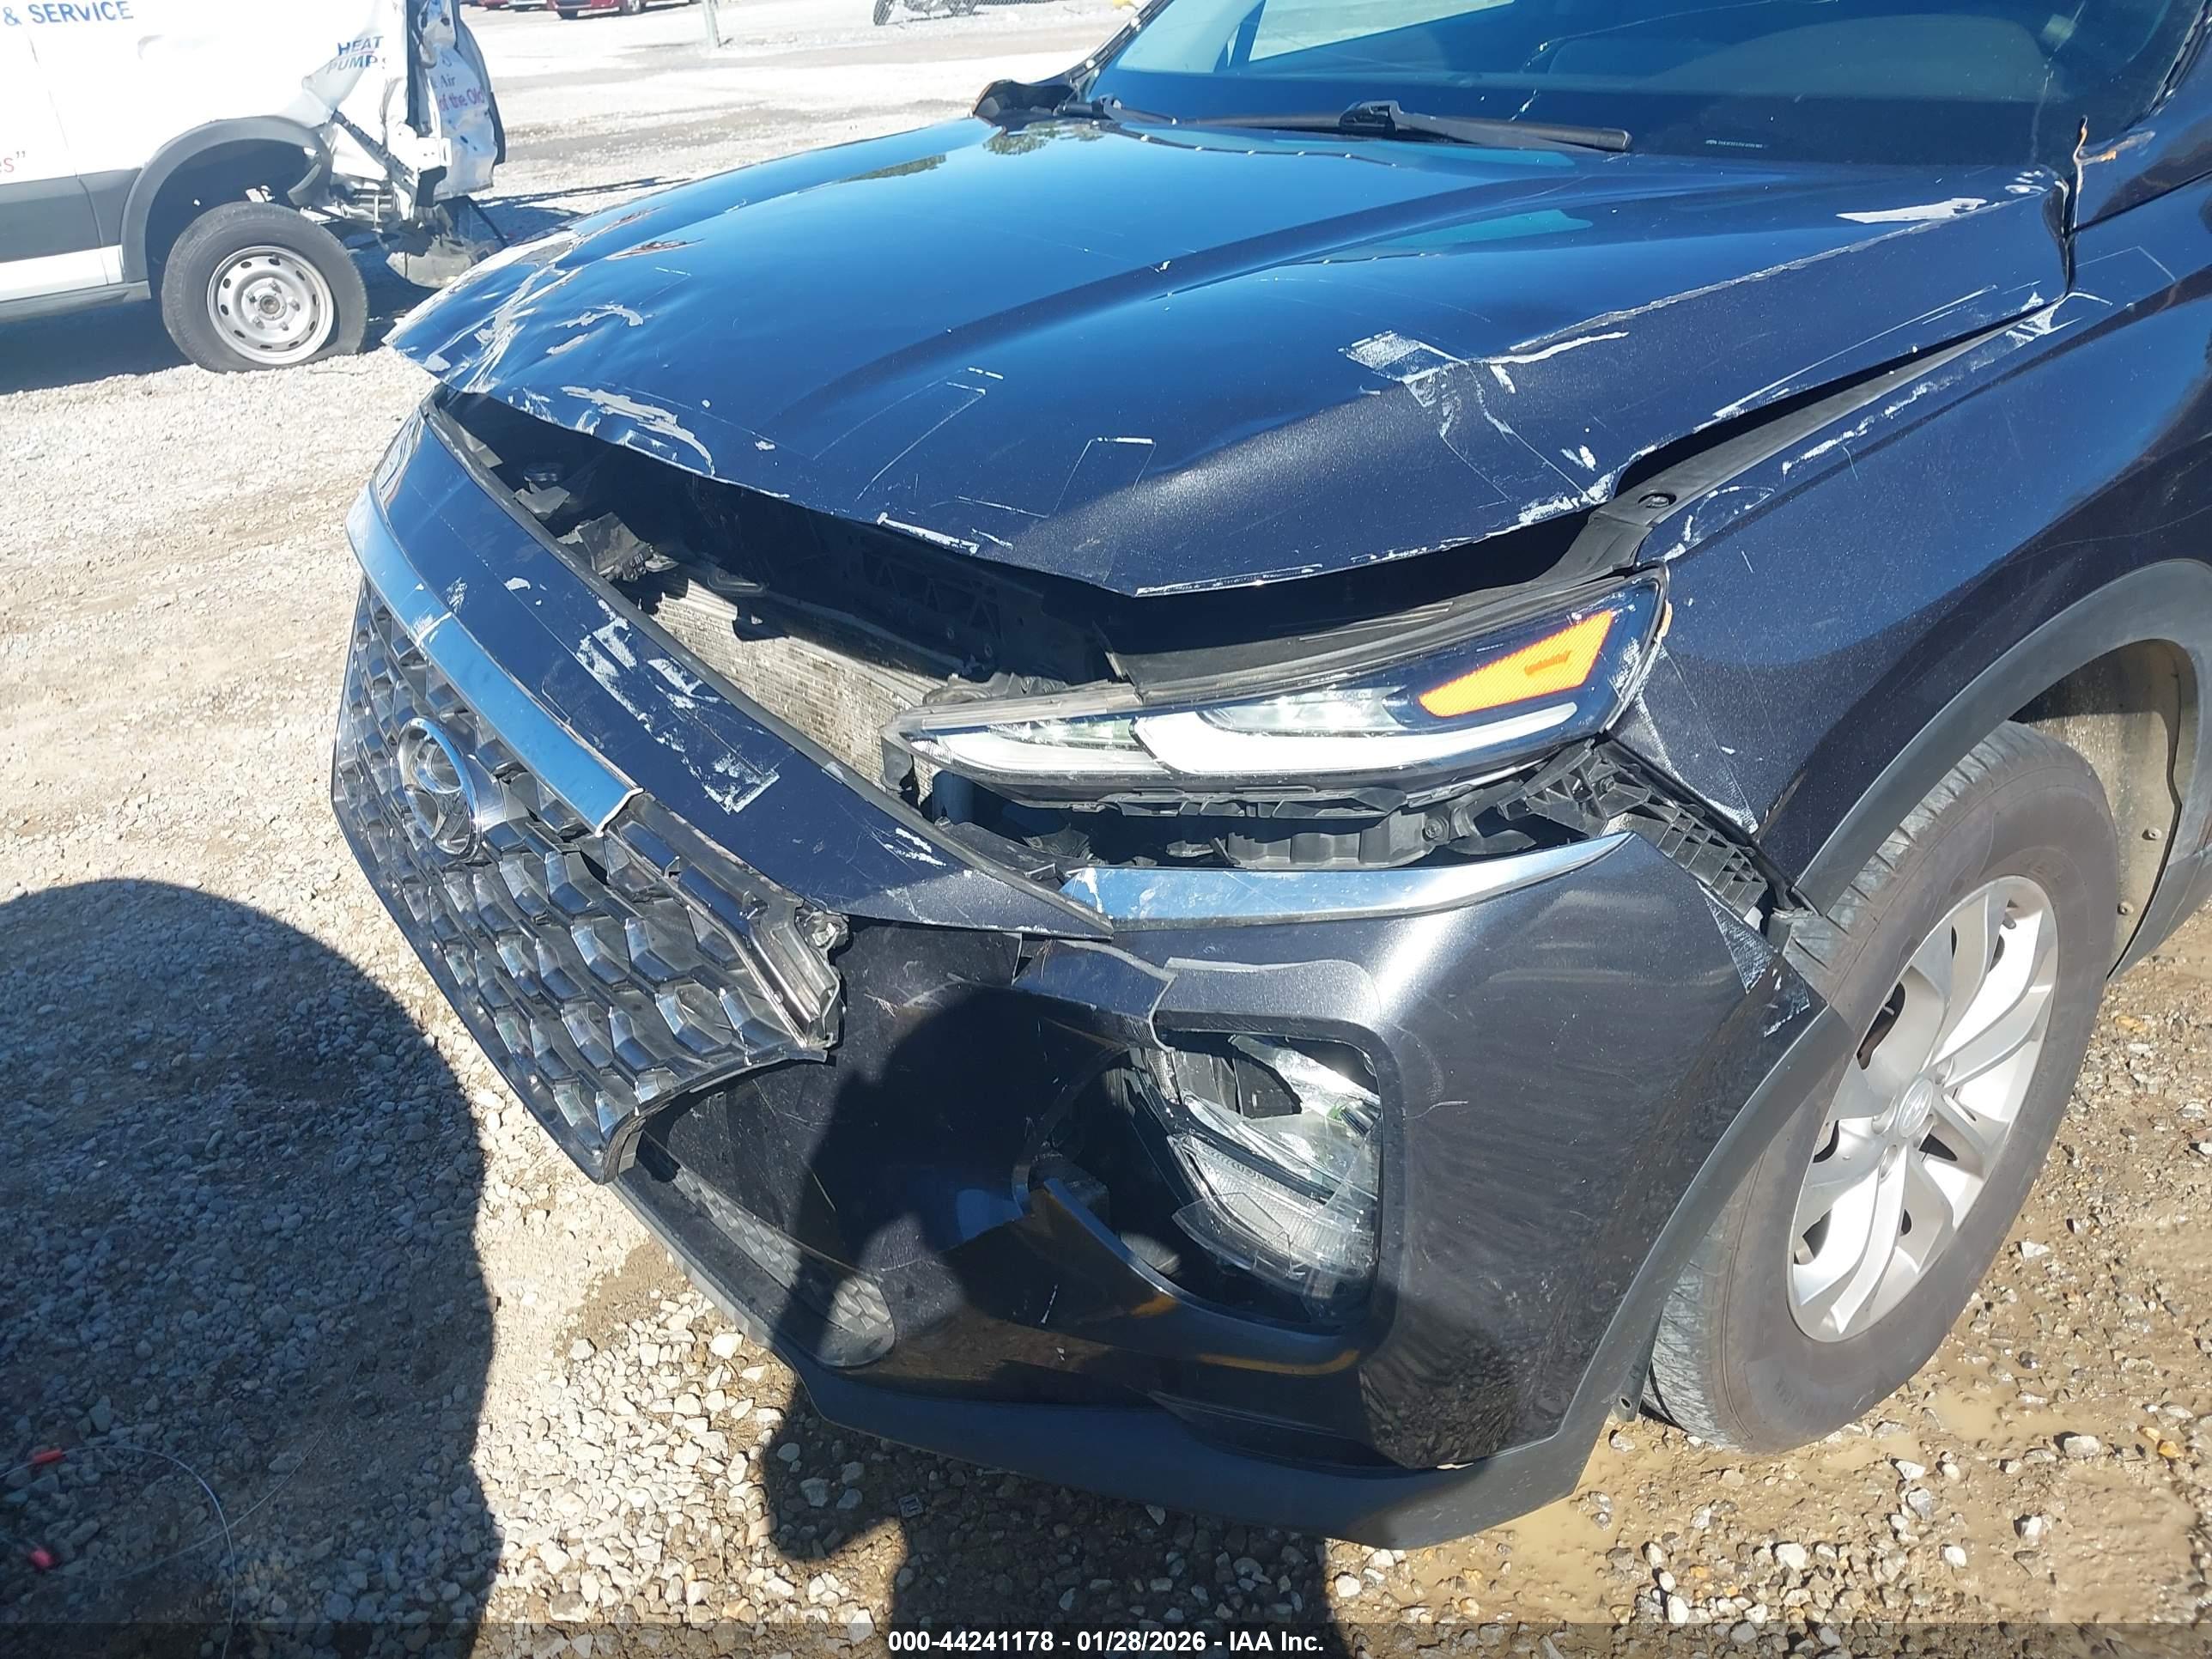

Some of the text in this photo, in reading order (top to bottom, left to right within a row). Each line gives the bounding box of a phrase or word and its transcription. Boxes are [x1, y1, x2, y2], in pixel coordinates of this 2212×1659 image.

[3, 1, 134, 27] & SERVICE
[337, 35, 384, 57] HEAT
[441, 74, 455, 88] Air
[448, 92, 468, 109] the
